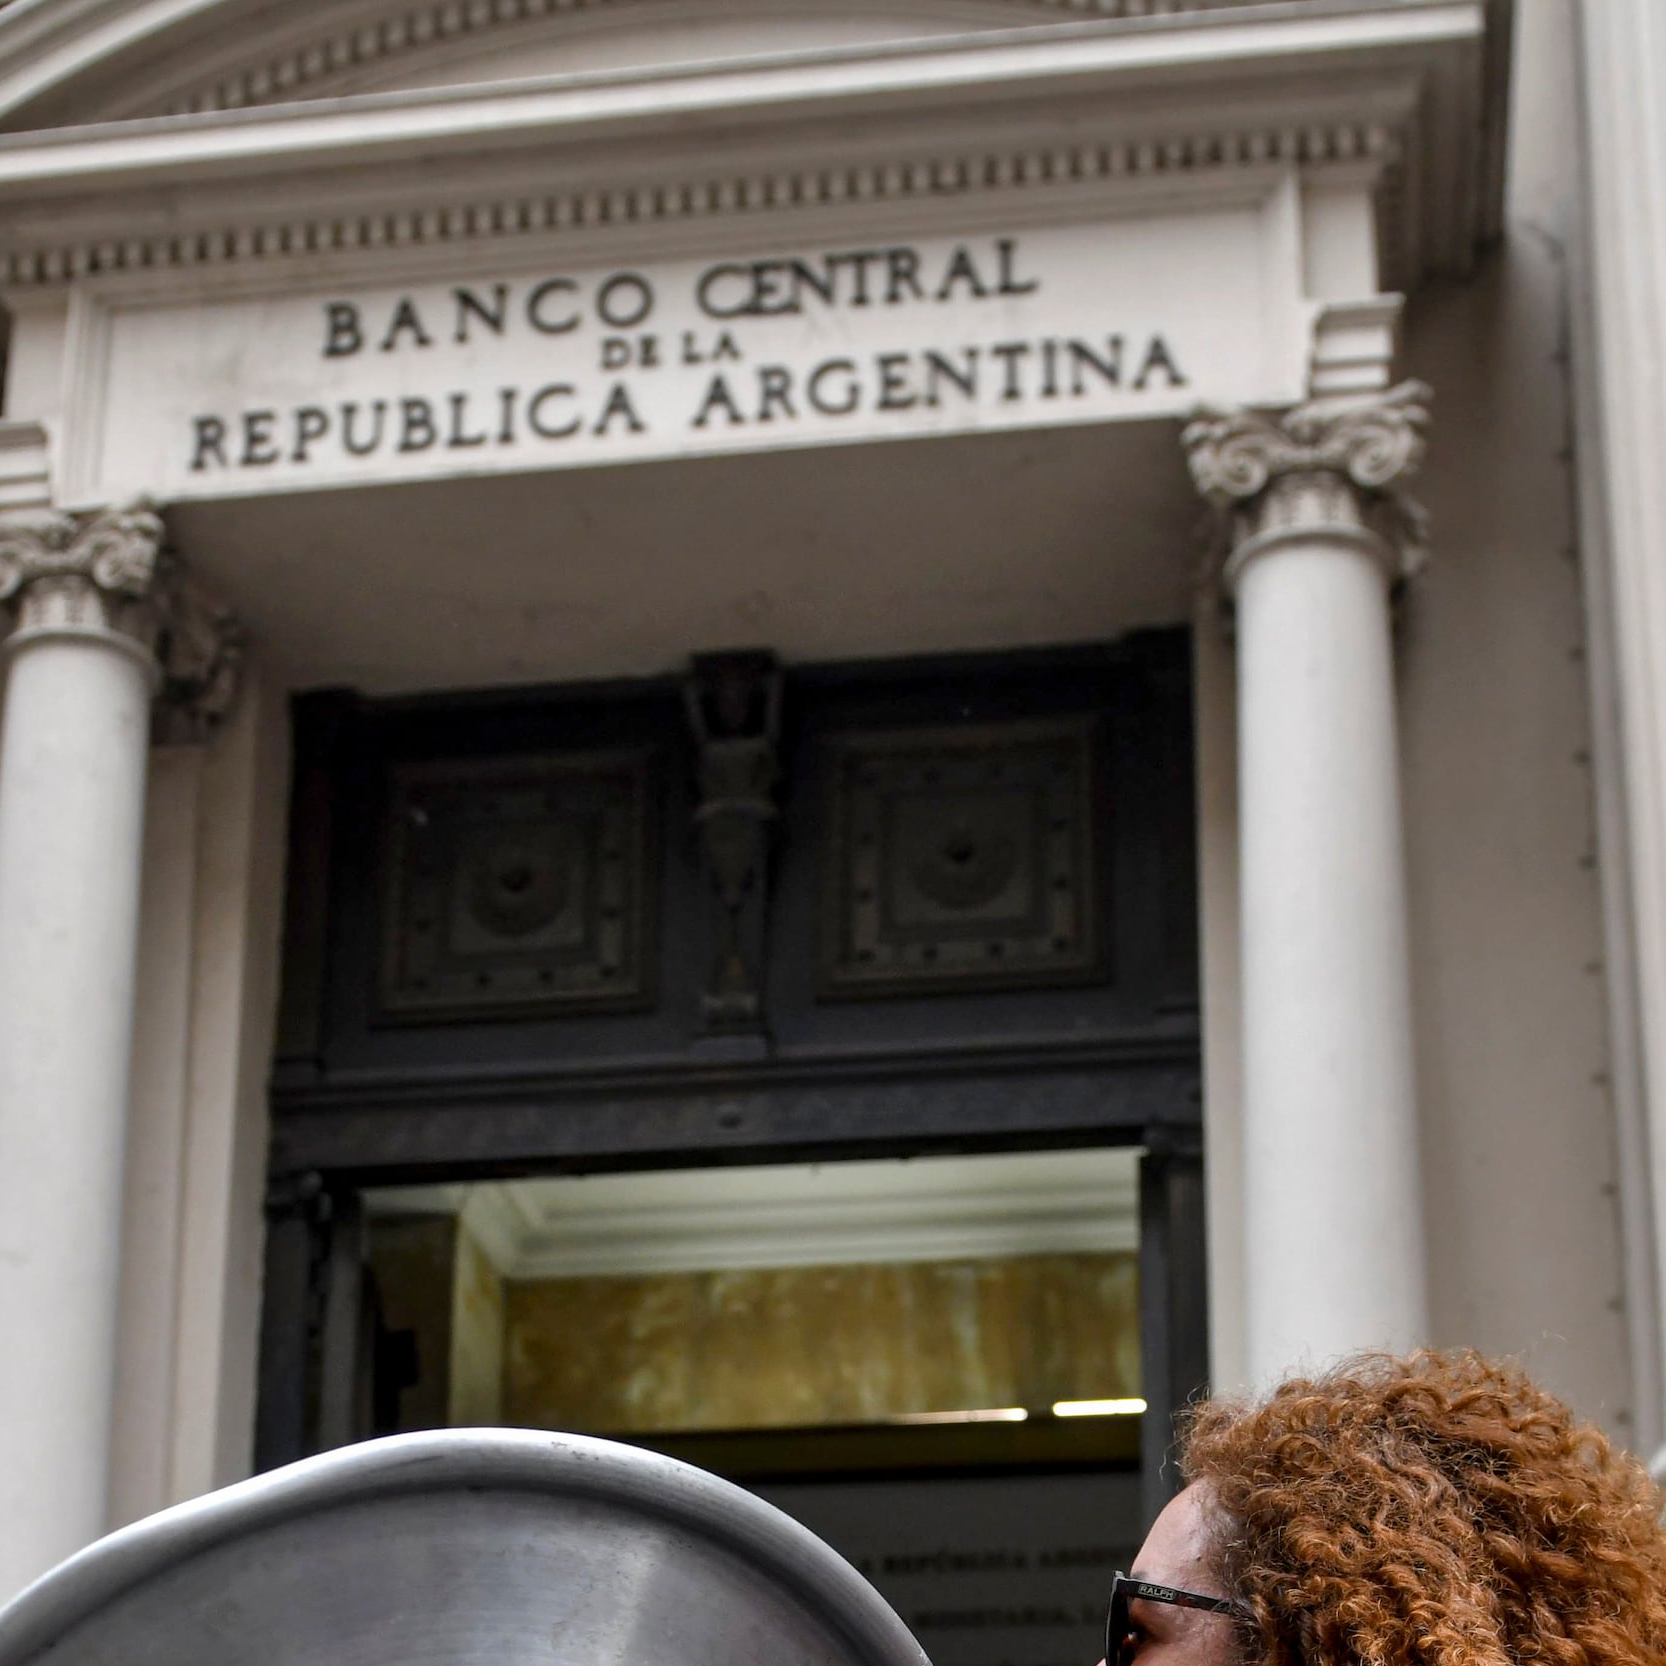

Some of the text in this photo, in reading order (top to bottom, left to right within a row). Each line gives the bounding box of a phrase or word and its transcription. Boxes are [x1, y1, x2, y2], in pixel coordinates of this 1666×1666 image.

[323, 240, 1039, 357] BANCO CENTRAL
[600, 331, 743, 370] DE LA
[190, 334, 1187, 471] REPUBLICA ARGENTINA
[1139, 1584, 1174, 1600] RALPH
